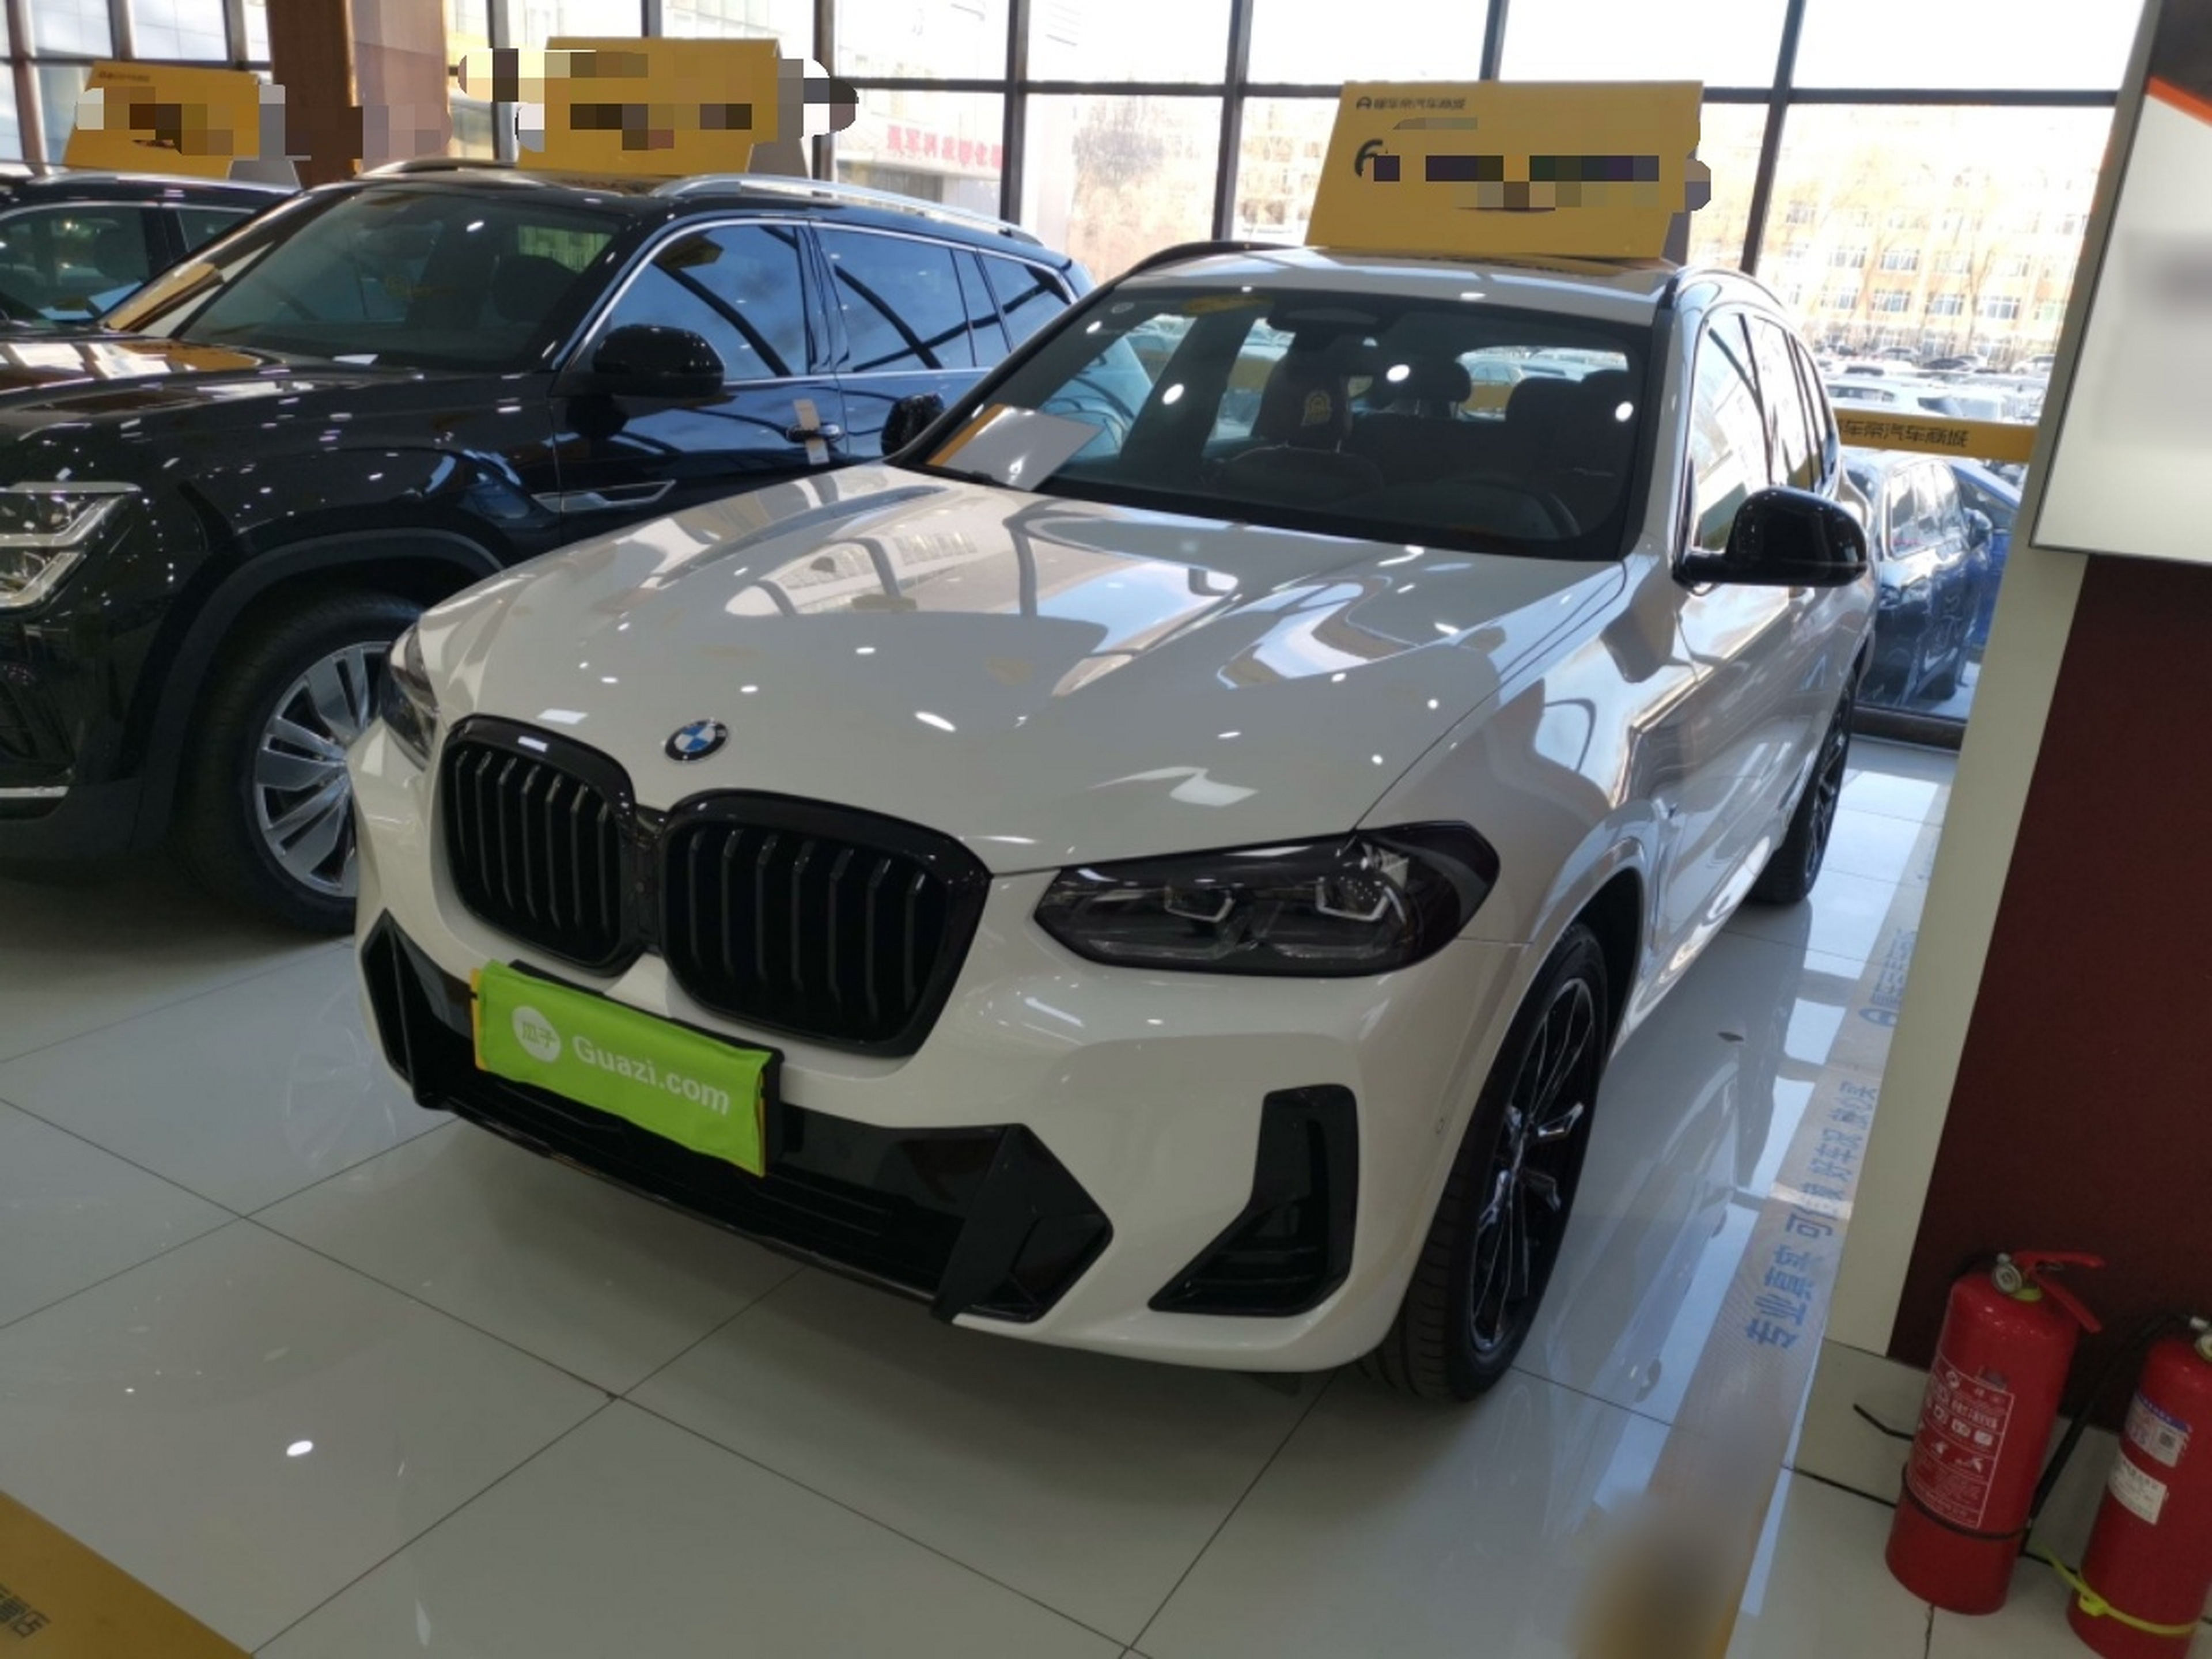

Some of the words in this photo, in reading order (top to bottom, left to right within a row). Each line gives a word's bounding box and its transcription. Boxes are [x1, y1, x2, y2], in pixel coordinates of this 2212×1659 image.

[1838, 419, 1969, 448] 车帝汽车商城
[572, 1035, 730, 1116] Guazi.com
